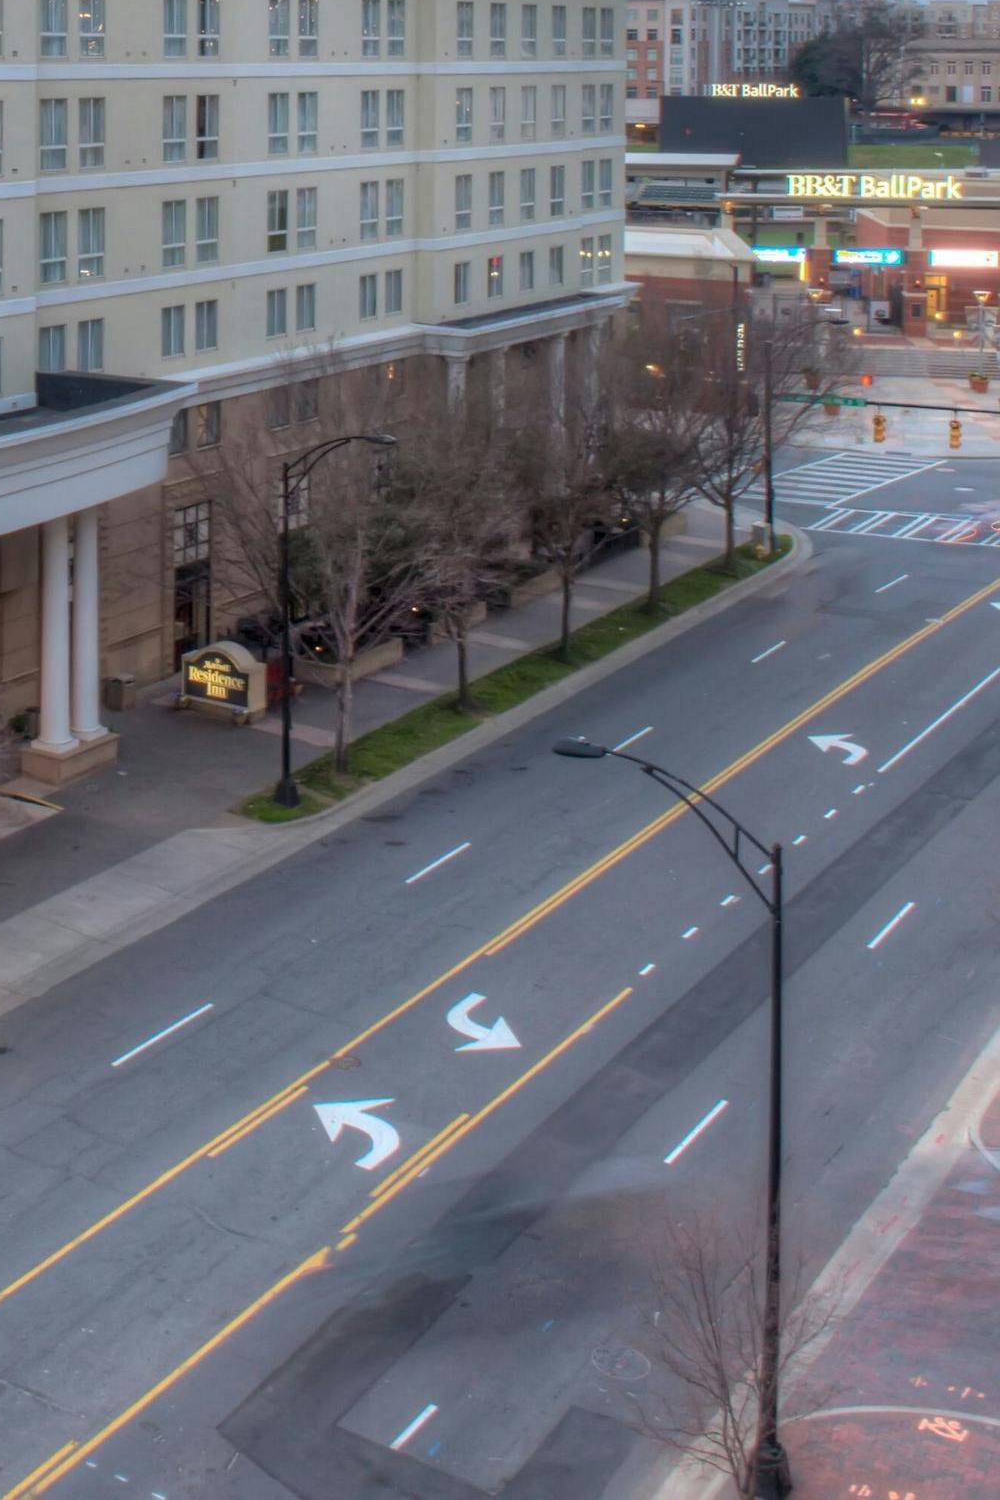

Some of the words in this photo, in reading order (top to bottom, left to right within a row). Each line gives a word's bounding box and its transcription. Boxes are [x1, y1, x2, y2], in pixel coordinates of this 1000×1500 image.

[742, 83, 800, 98] BallPark
[786, 174, 856, 197] BB&T
[860, 174, 963, 199] BallPark
[188, 665, 246, 691] Residence
[206, 681, 228, 699] Inn
